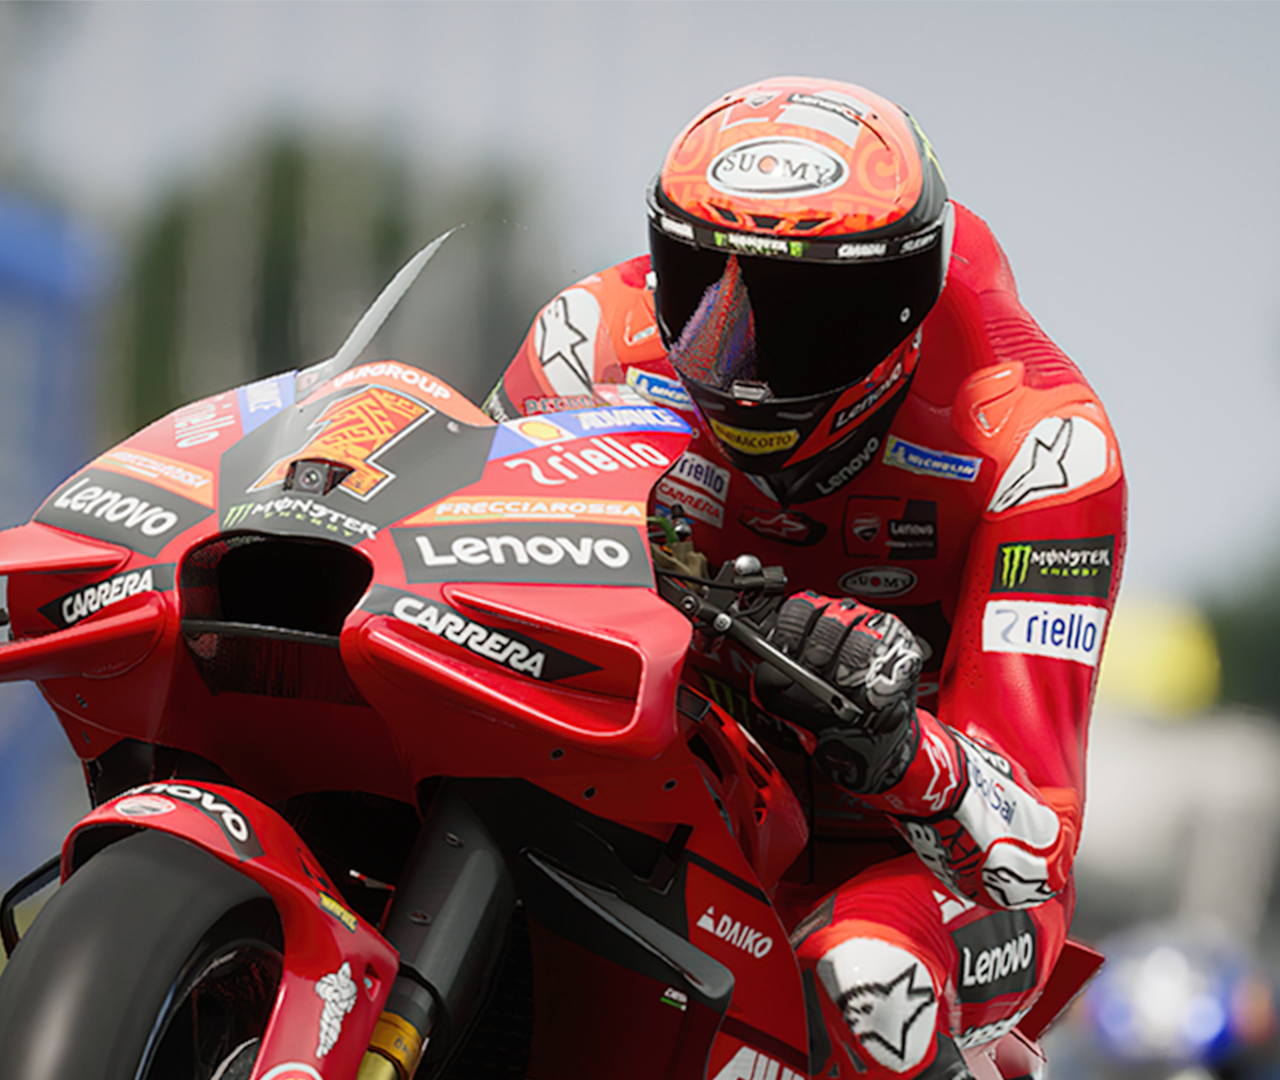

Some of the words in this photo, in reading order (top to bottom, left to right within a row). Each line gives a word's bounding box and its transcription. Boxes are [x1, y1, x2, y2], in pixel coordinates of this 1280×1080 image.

[722, 151, 831, 188] SUOMY
[835, 362, 903, 428] Lenovo
[547, 437, 670, 481] riello
[679, 456, 725, 494] riello
[815, 436, 880, 495] Lenovo
[907, 453, 976, 476] MICHELIN
[53, 477, 179, 537] Lenovo
[435, 500, 642, 517] FRECCIAROSSA
[658, 482, 721, 520] CARRERA
[415, 535, 631, 569] Lenovo
[61, 568, 154, 624] CARRERA
[392, 597, 546, 679] CARRERA
[1026, 610, 1097, 652] riello
[715, 914, 773, 959] DAIKO
[962, 932, 1034, 987] Lenovo
